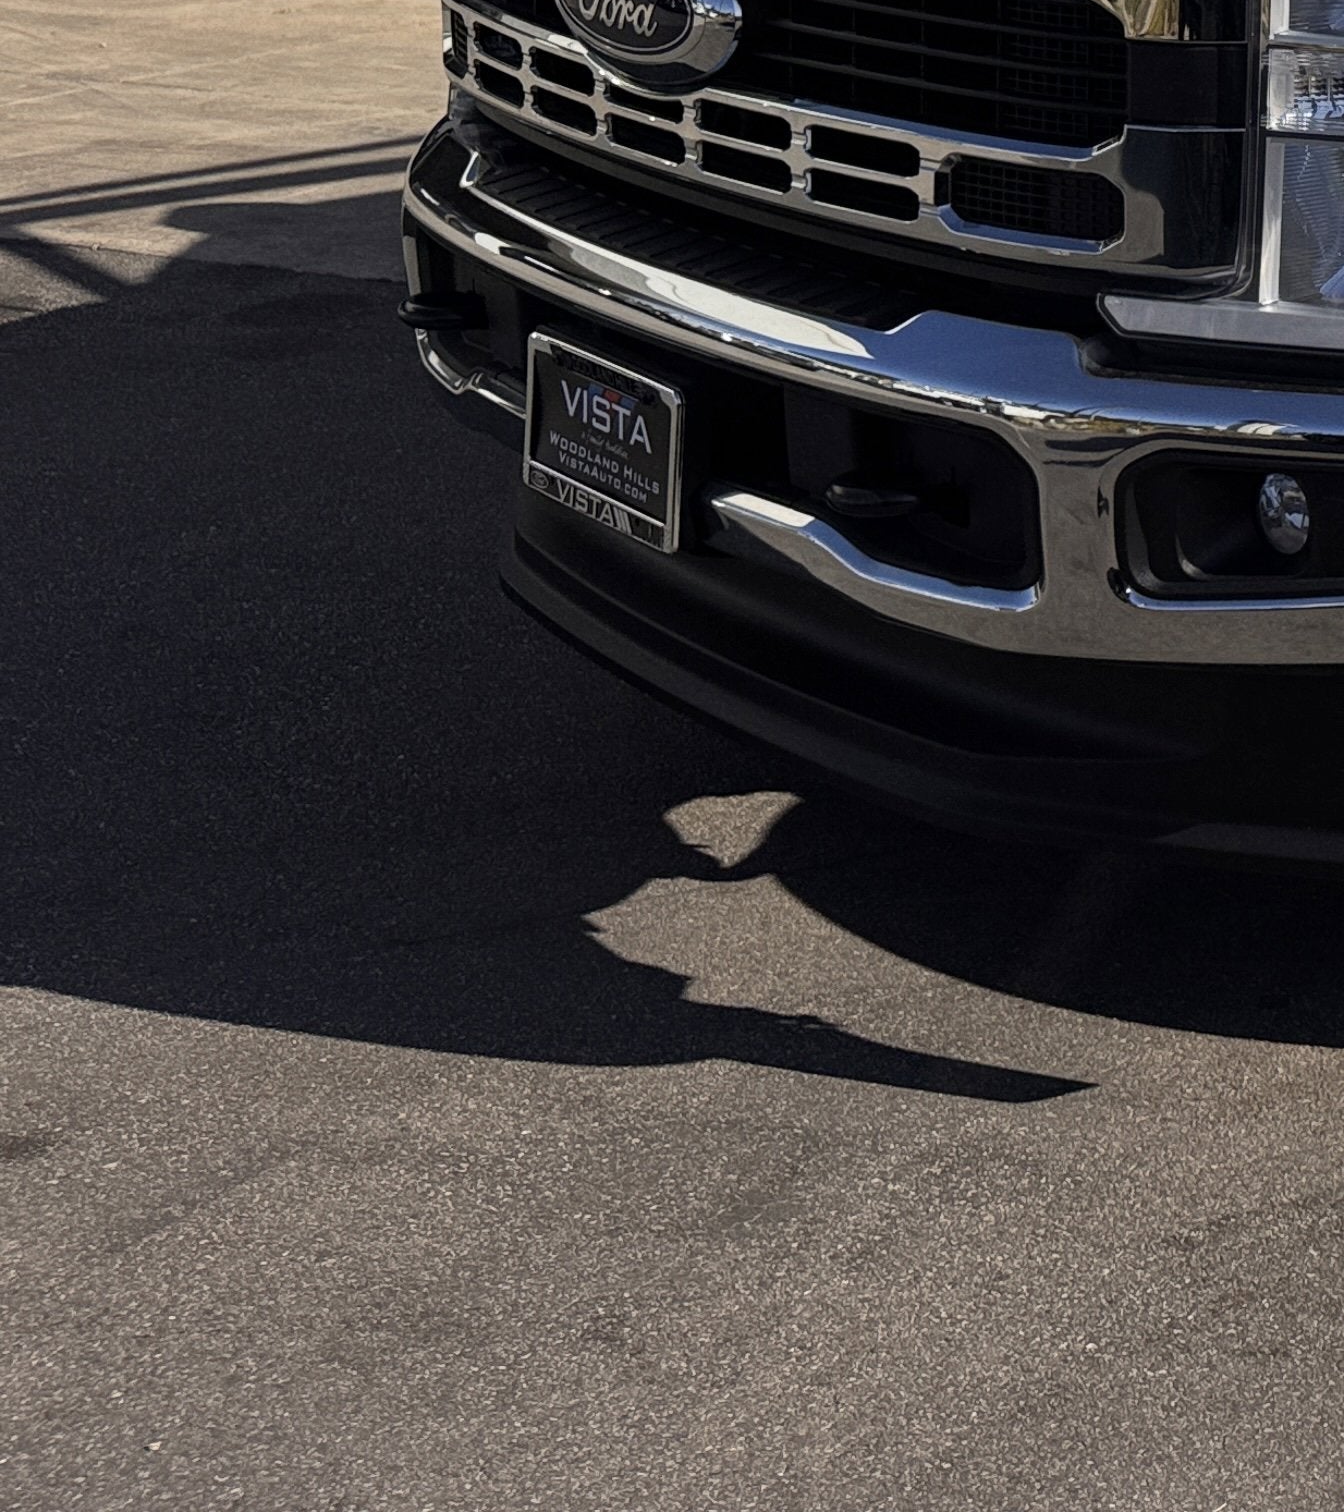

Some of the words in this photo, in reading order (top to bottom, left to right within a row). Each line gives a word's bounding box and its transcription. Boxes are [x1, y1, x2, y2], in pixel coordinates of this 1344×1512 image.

[561, 379, 652, 455] VISTA
[549, 429, 620, 474] WOODLAND
[623, 464, 661, 496] HILLS
[556, 477, 615, 528] VISTA
